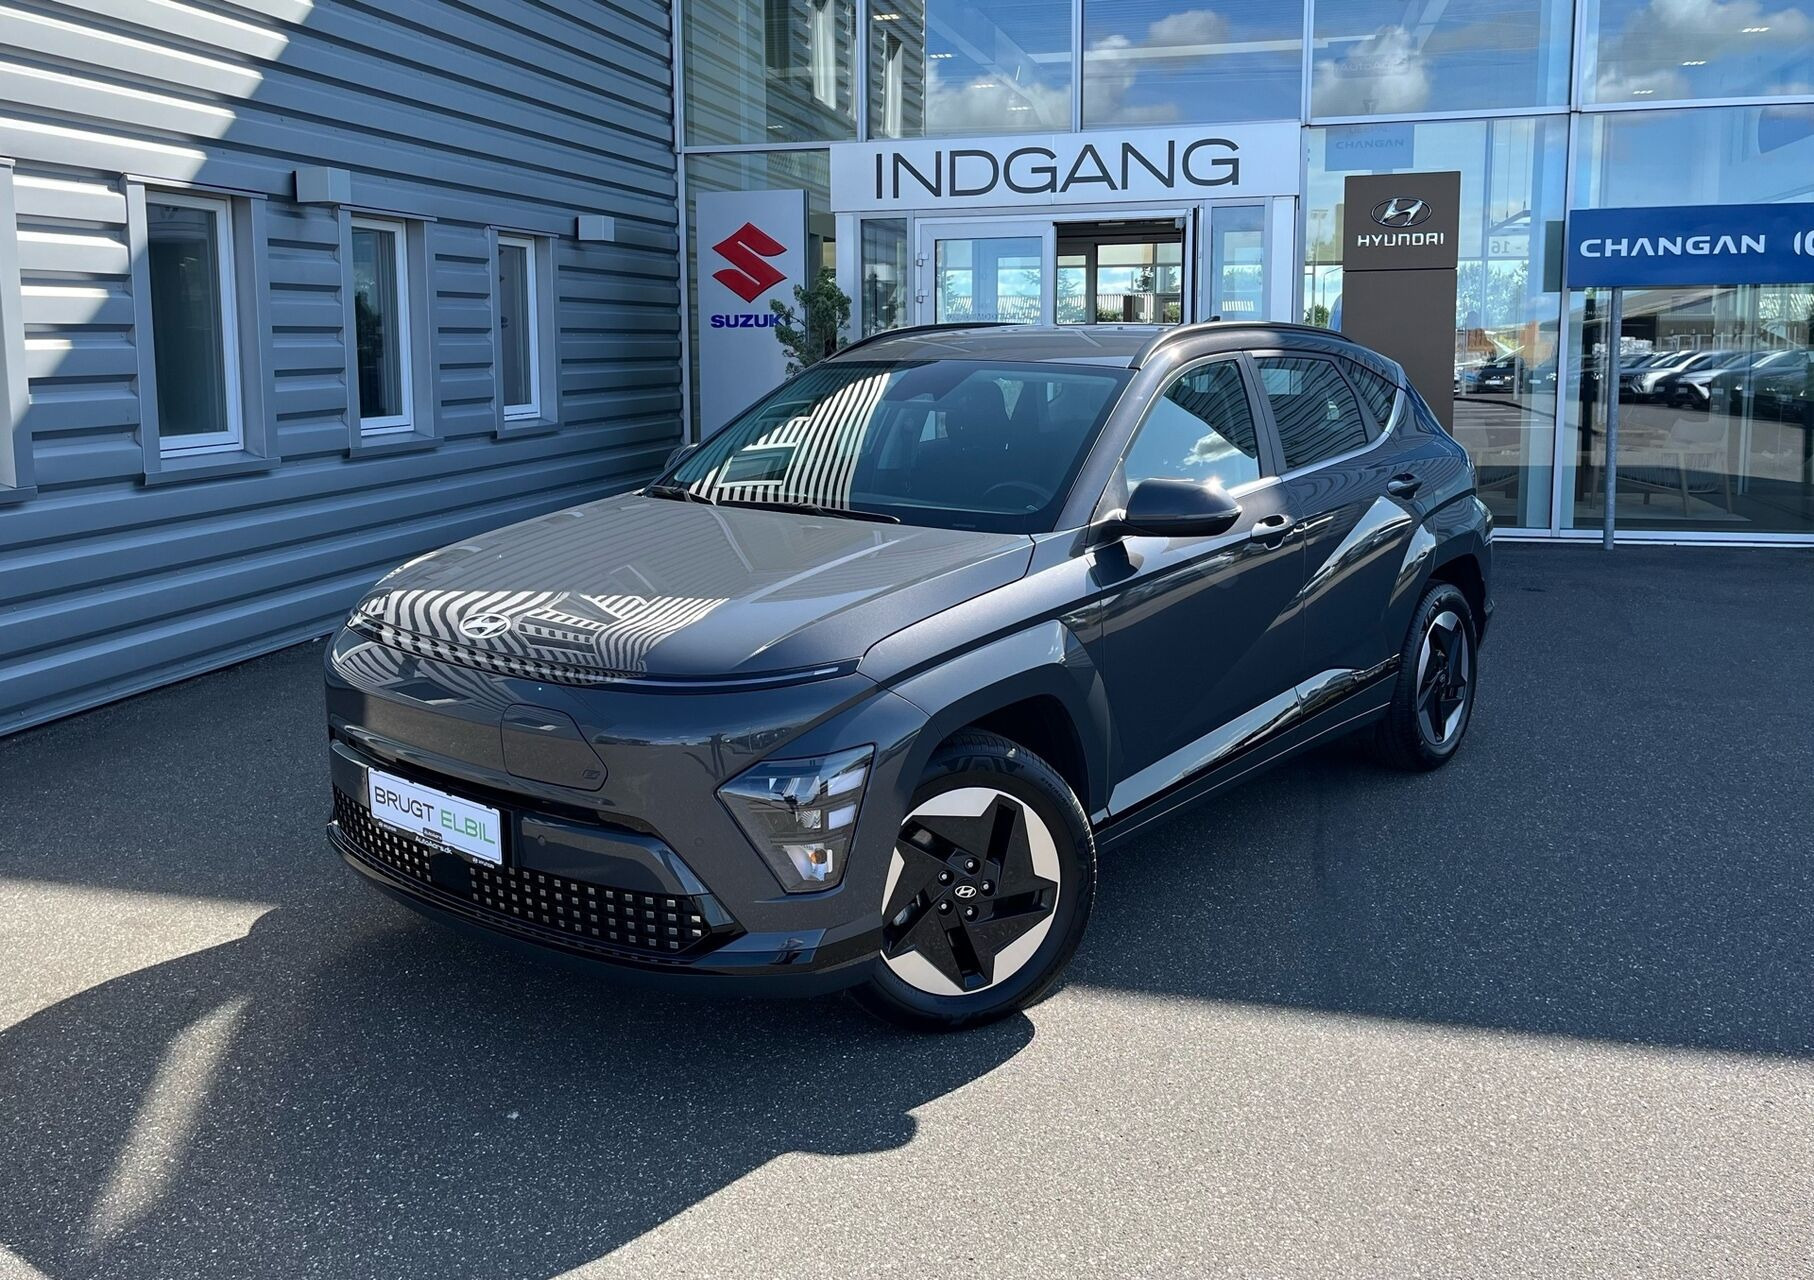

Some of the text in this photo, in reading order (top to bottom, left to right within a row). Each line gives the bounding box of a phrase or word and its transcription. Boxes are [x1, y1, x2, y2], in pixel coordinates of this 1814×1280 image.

[875, 138, 1240, 200] INDGANG
[1357, 232, 1444, 247] HYUNDAI
[1579, 234, 1766, 258] CHANGAN
[374, 785, 496, 845] BRUGT ELBIL
